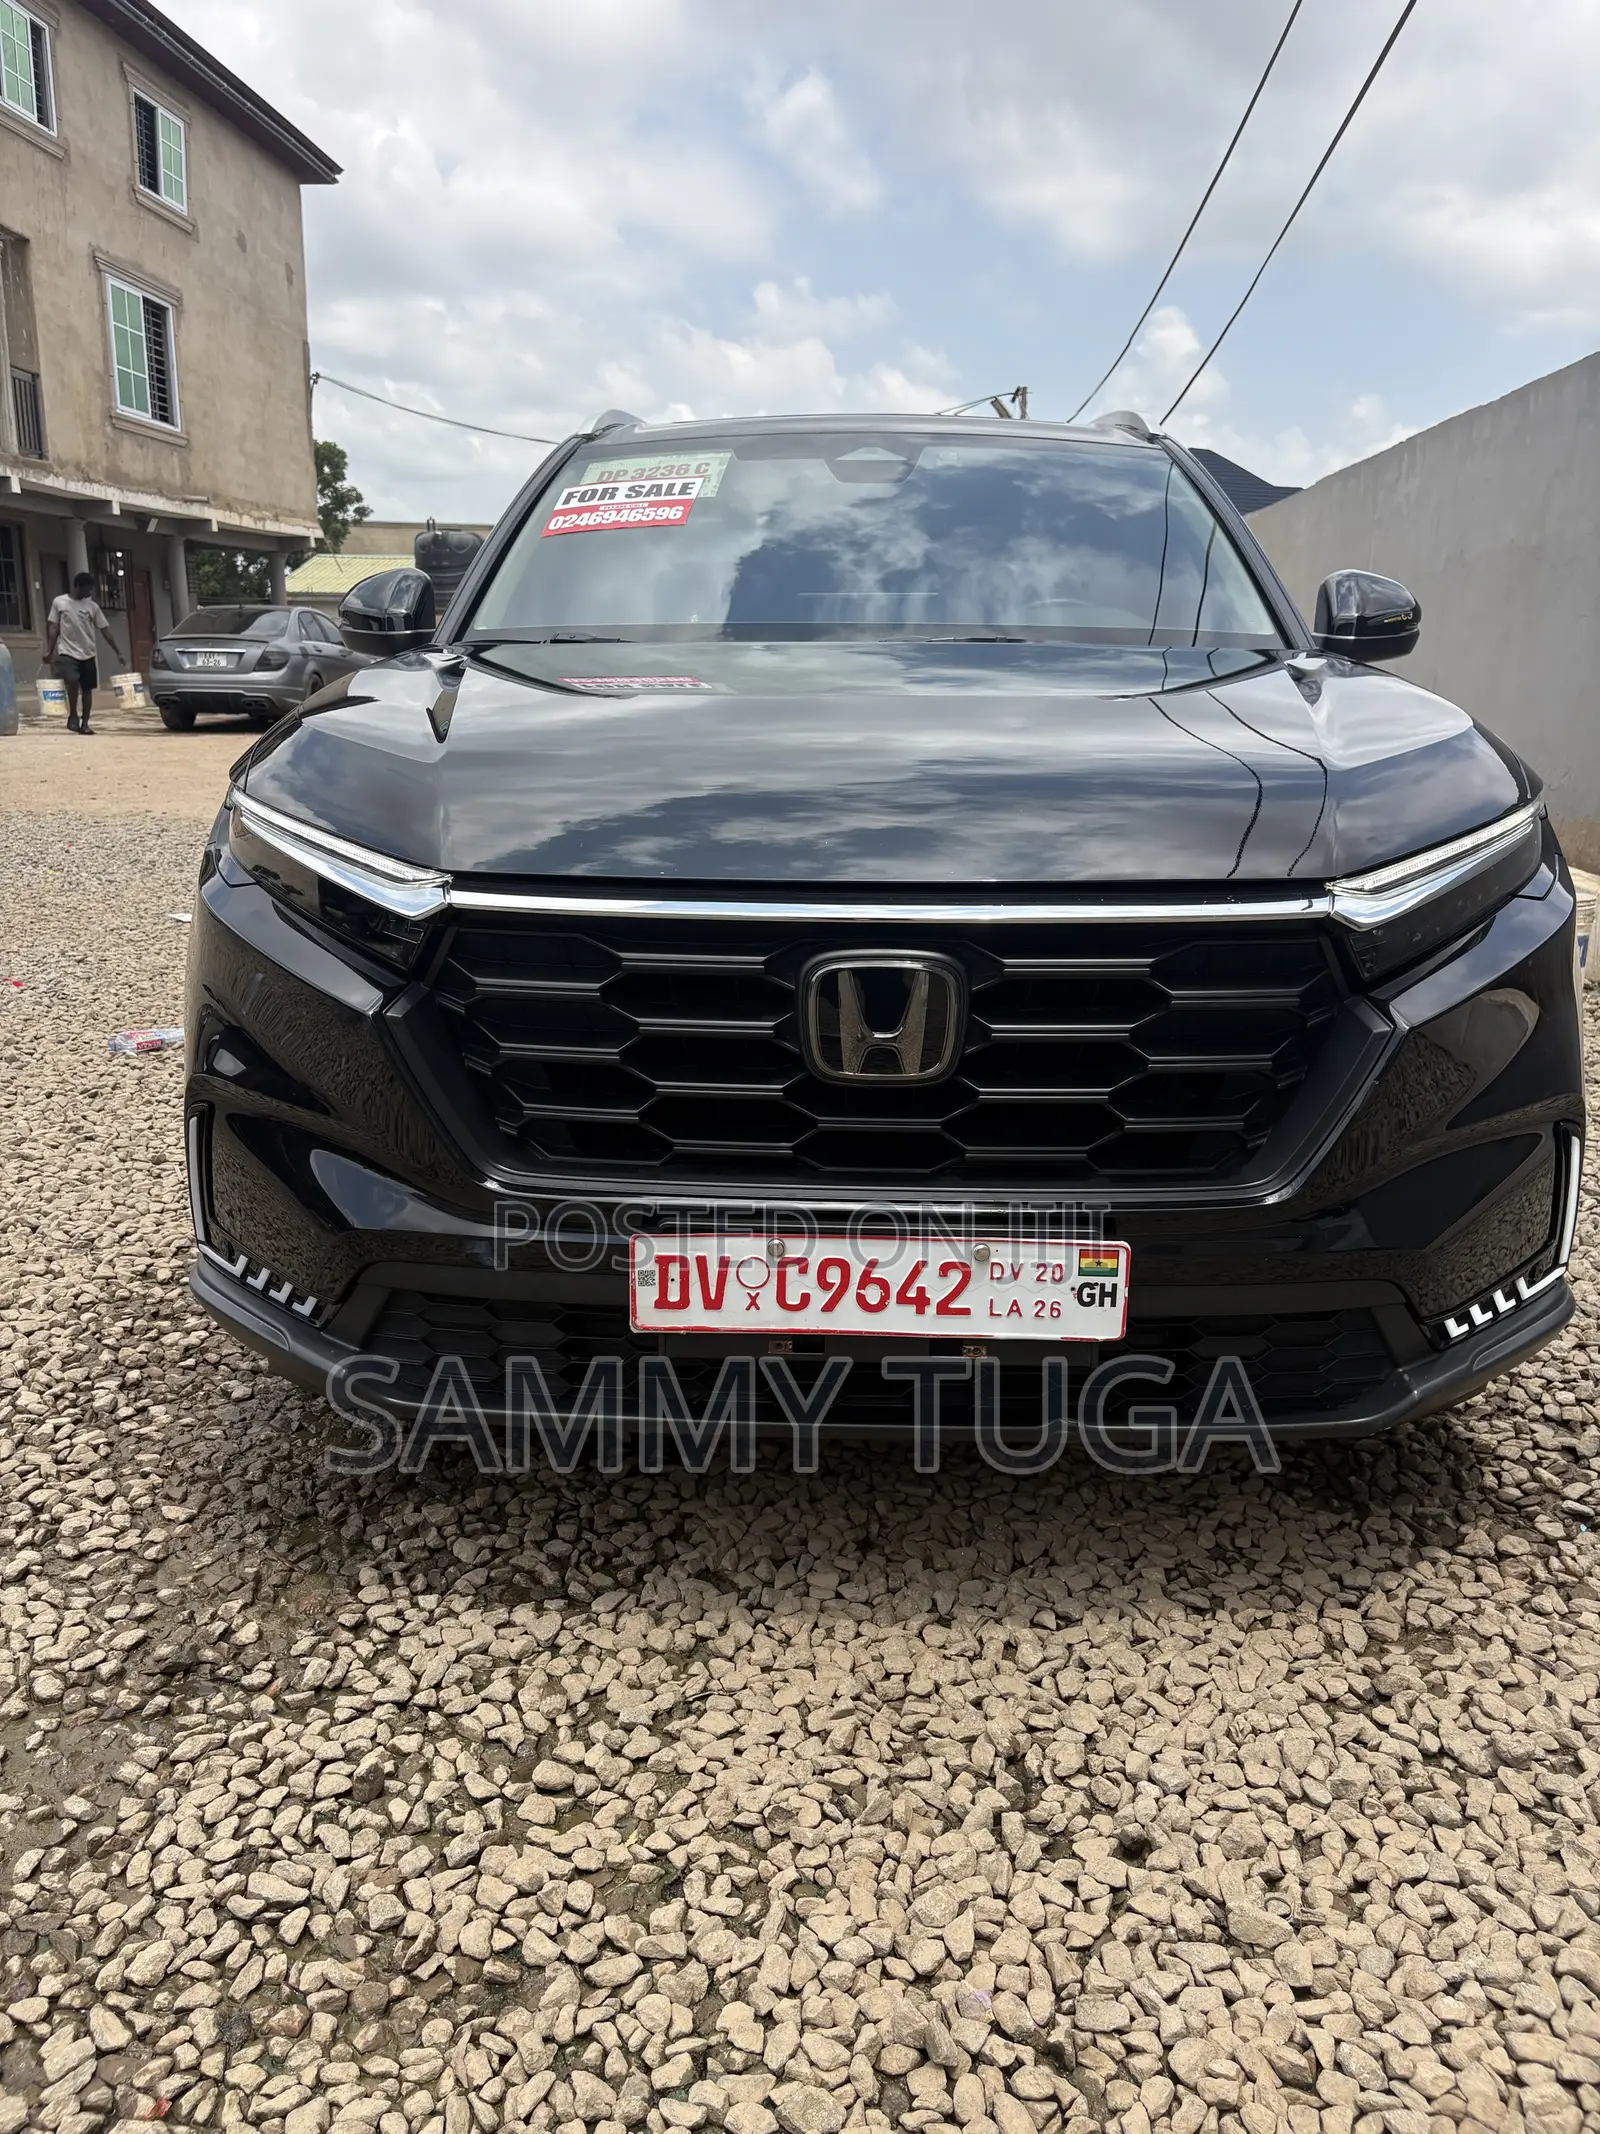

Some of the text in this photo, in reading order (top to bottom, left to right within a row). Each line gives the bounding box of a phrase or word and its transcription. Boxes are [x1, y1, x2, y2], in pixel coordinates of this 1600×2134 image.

[596, 462, 711, 482] DP 3236 C
[562, 487, 619, 506] FOR
[624, 481, 696, 499] SALE
[548, 505, 684, 530] 0246946596
[989, 1260, 1065, 1283] DV 20
[653, 1254, 731, 1310] DV
[776, 1255, 972, 1316] C9642
[1076, 1282, 1118, 1308] GH
[989, 1298, 1062, 1319] LA 26
